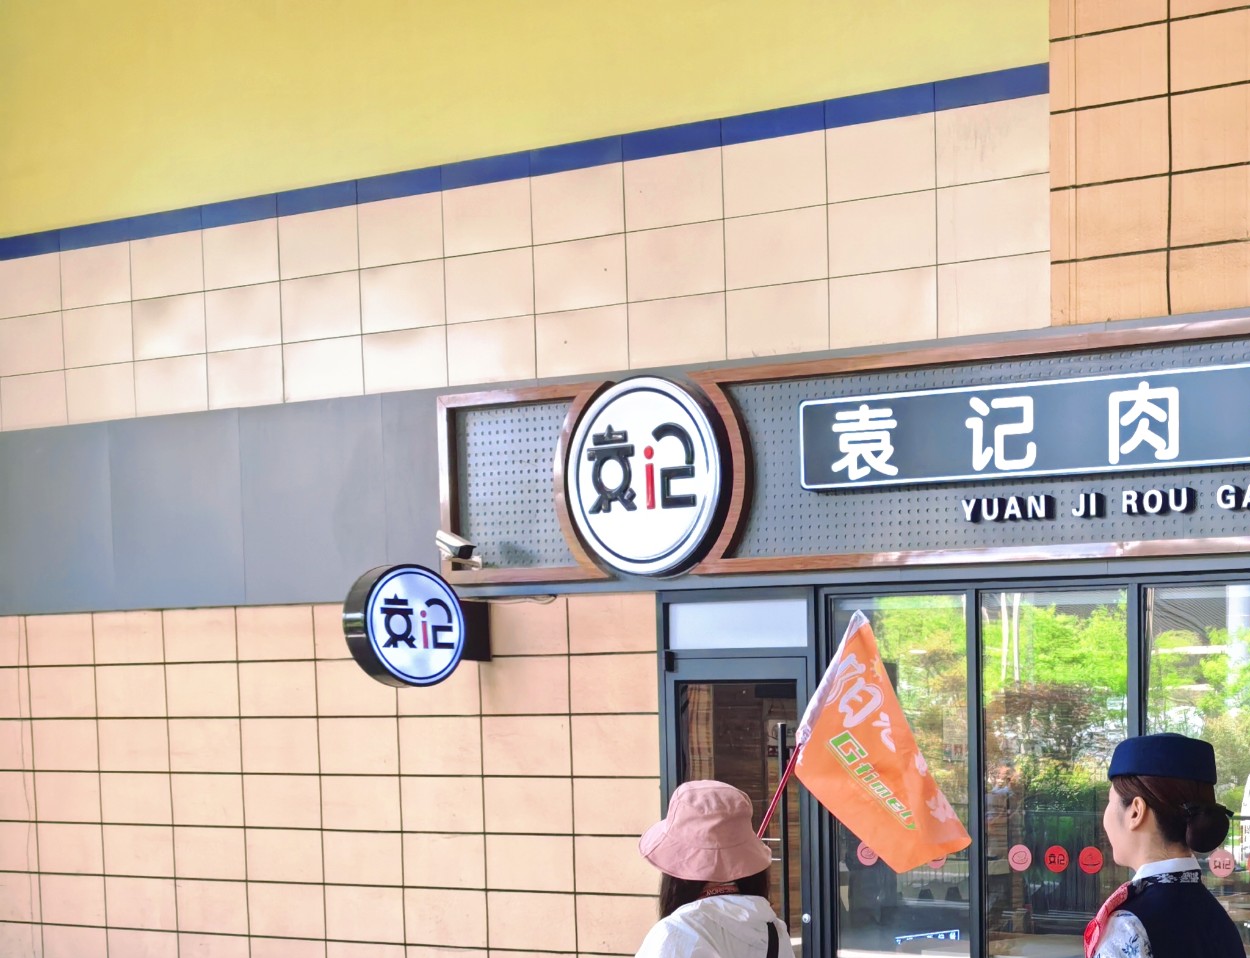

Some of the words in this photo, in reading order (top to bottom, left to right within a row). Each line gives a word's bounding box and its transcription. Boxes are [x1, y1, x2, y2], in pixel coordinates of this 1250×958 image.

[962, 494, 1049, 521] YUAN
[1072, 491, 1097, 518] JI
[1121, 486, 1189, 514] ROU
